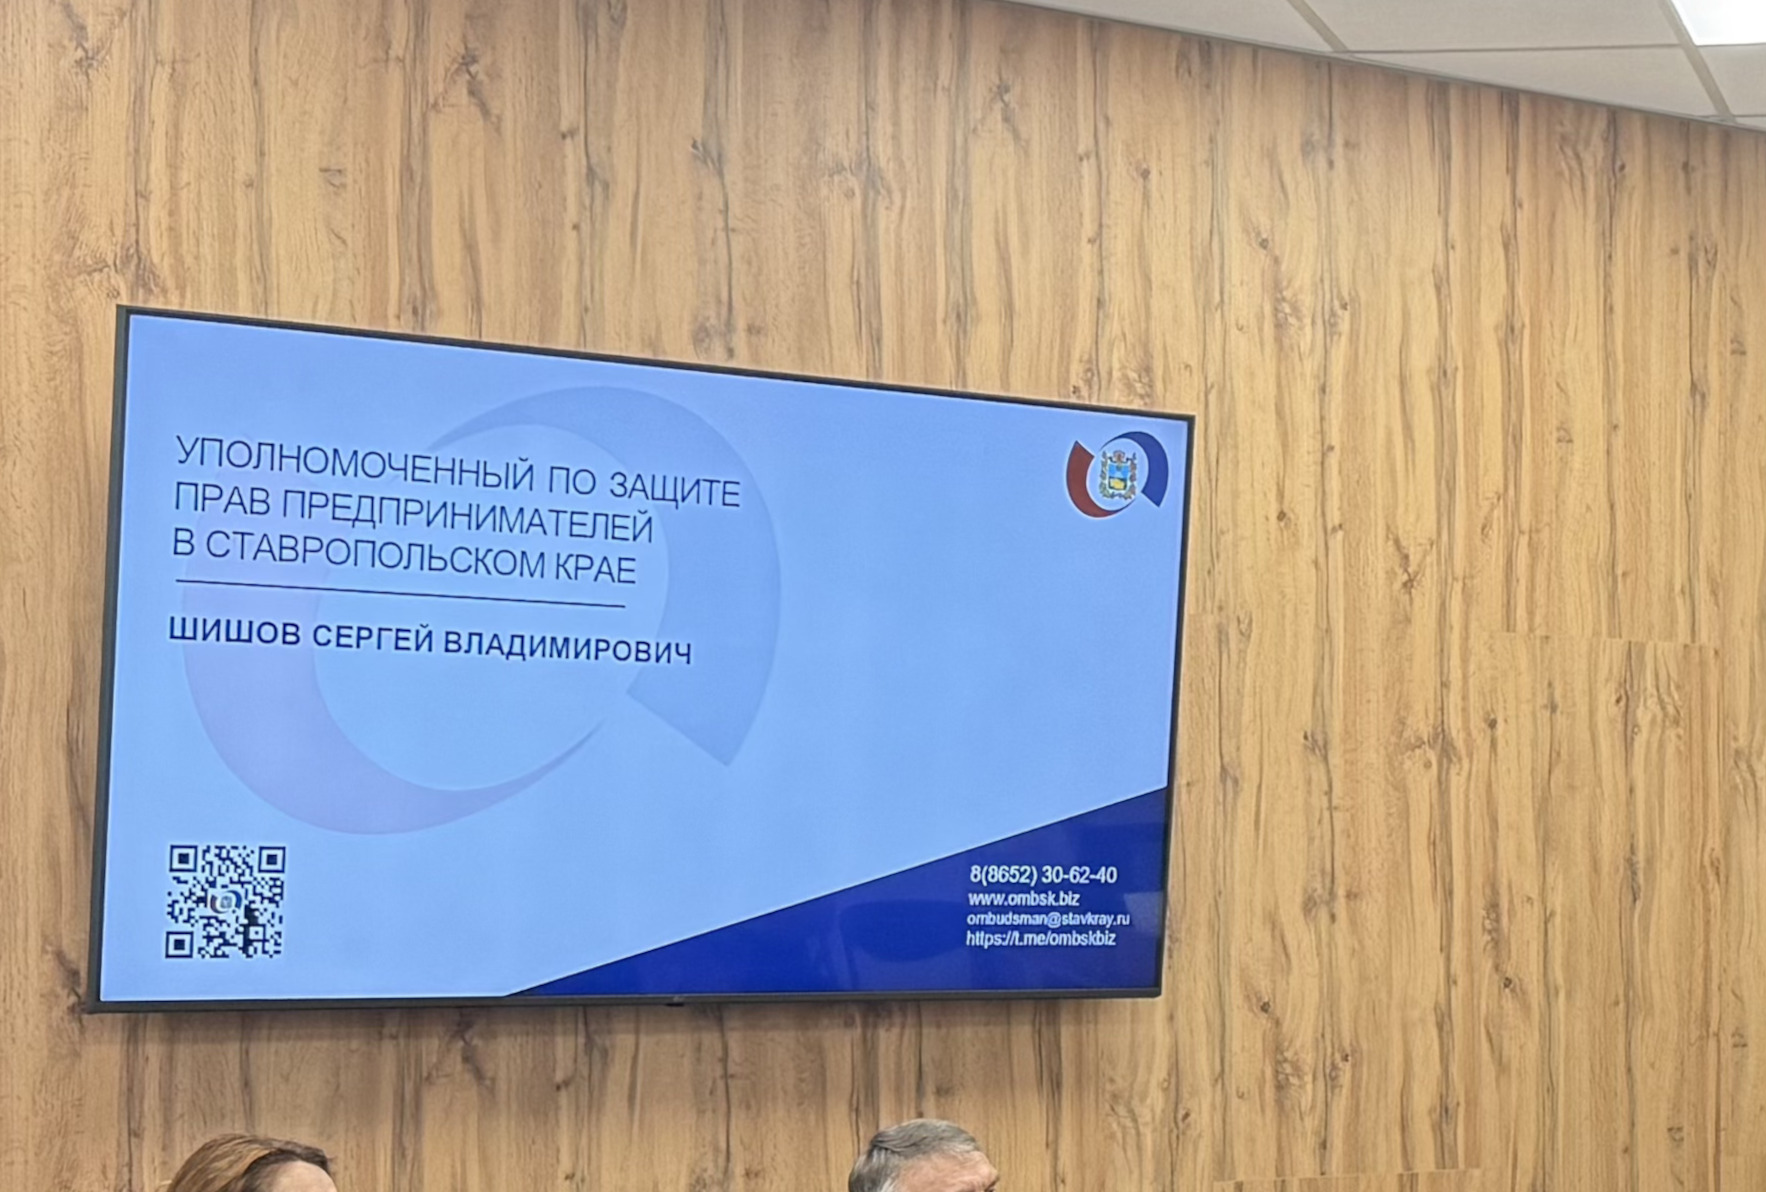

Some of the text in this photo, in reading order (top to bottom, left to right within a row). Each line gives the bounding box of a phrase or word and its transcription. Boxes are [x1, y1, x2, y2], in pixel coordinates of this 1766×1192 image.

[176, 435, 741, 509] УПОЛНОМОЧЕННЫЙ ПО ЗАЩИТЕ
[174, 481, 653, 543] ПРАВ ПРЕДПРИНИМАТЕЛЕЙ
[173, 528, 637, 585] В СТАВРОПОЛЬСКОМ КРАЕ
[168, 615, 693, 665] ШИШОВ СЕРГЕЙ ВЛАДИМИРОВИЧ
[970, 864, 1118, 887] 8(8652) 30-62-40
[968, 890, 1081, 907] www.ombsk.biz
[966, 912, 1130, 928] ombudsman@stavkray.ru
[966, 930, 1117, 949] https://t.me/ombskbiz
